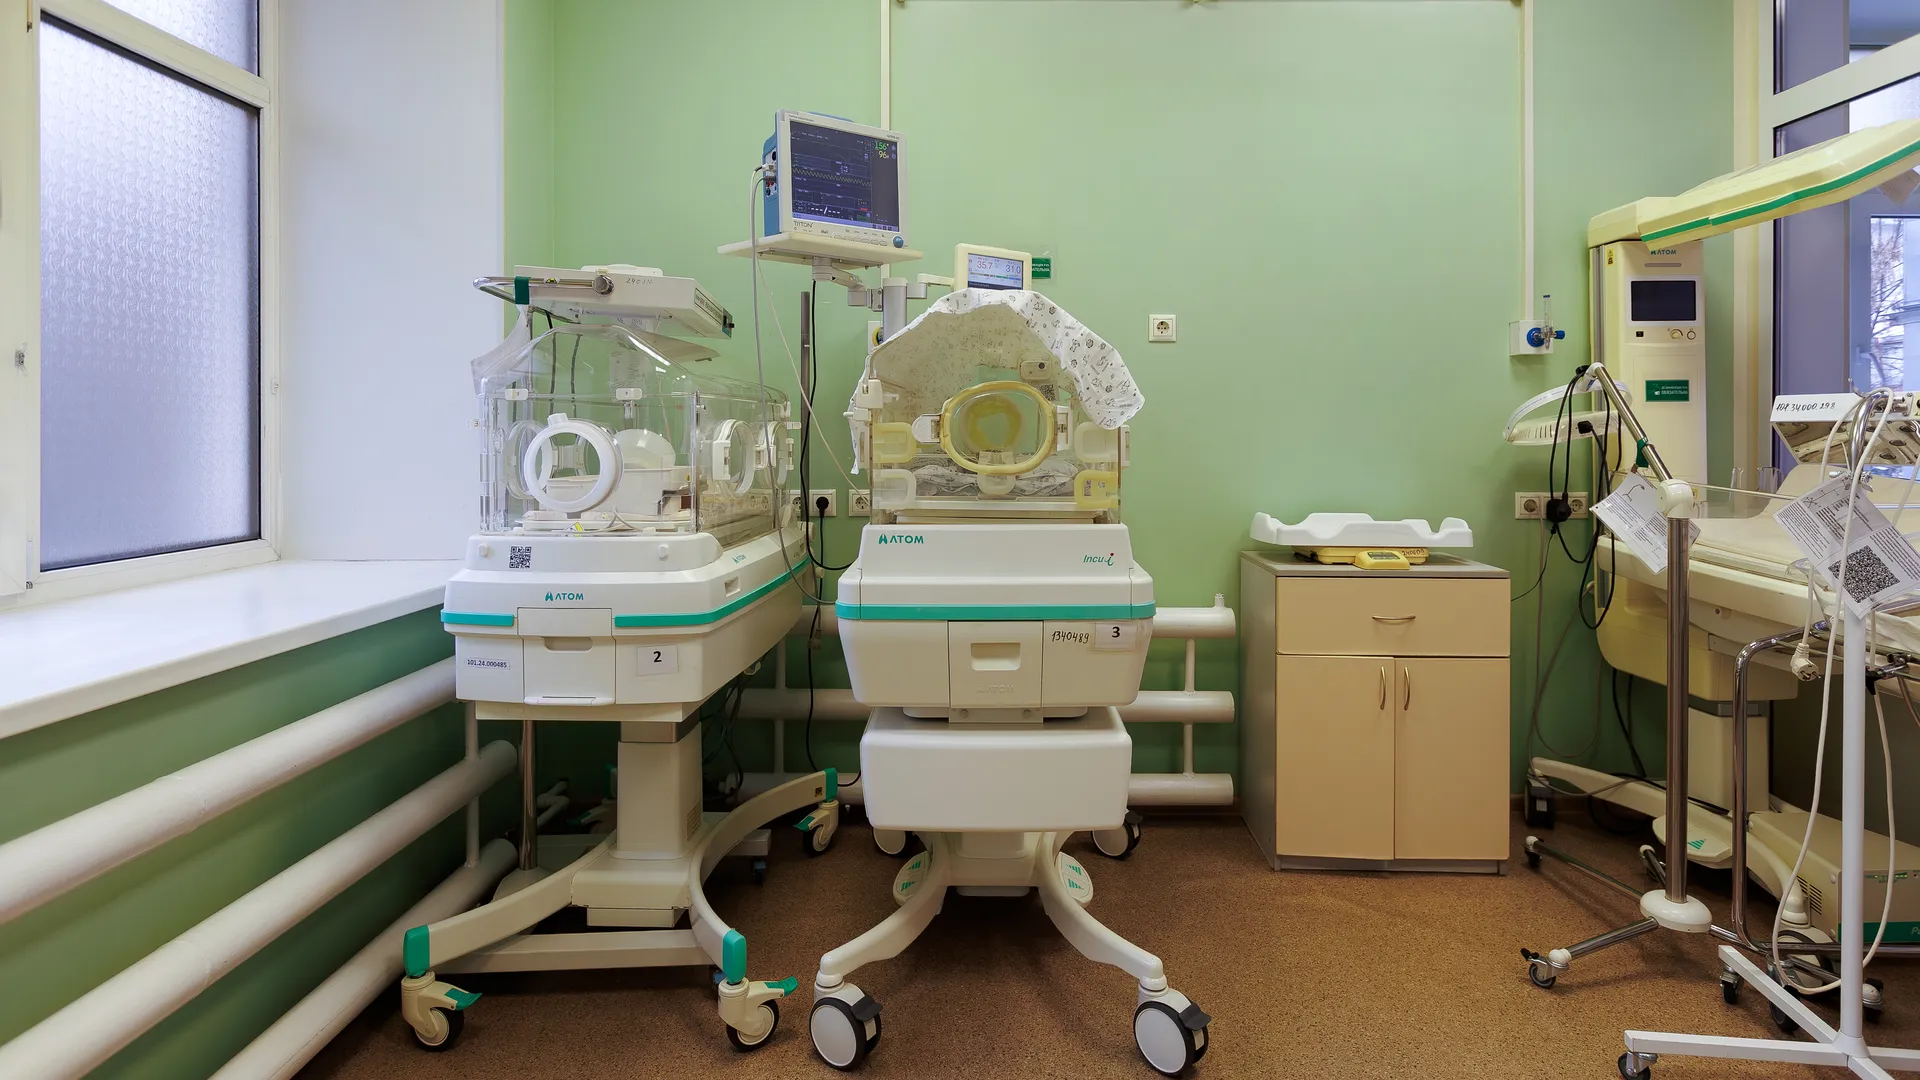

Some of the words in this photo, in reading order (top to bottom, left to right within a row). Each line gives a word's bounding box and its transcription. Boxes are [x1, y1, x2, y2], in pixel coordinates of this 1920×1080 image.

[874, 140, 887, 150] 156
[977, 260, 993, 270] 35.7
[1005, 264, 1021, 274] 31.0
[889, 535, 924, 544] ATOM
[555, 592, 584, 601] ATOM
[1051, 625, 1090, 644] 1340489
[1111, 626, 1121, 638] 3
[653, 650, 663, 663] 2
